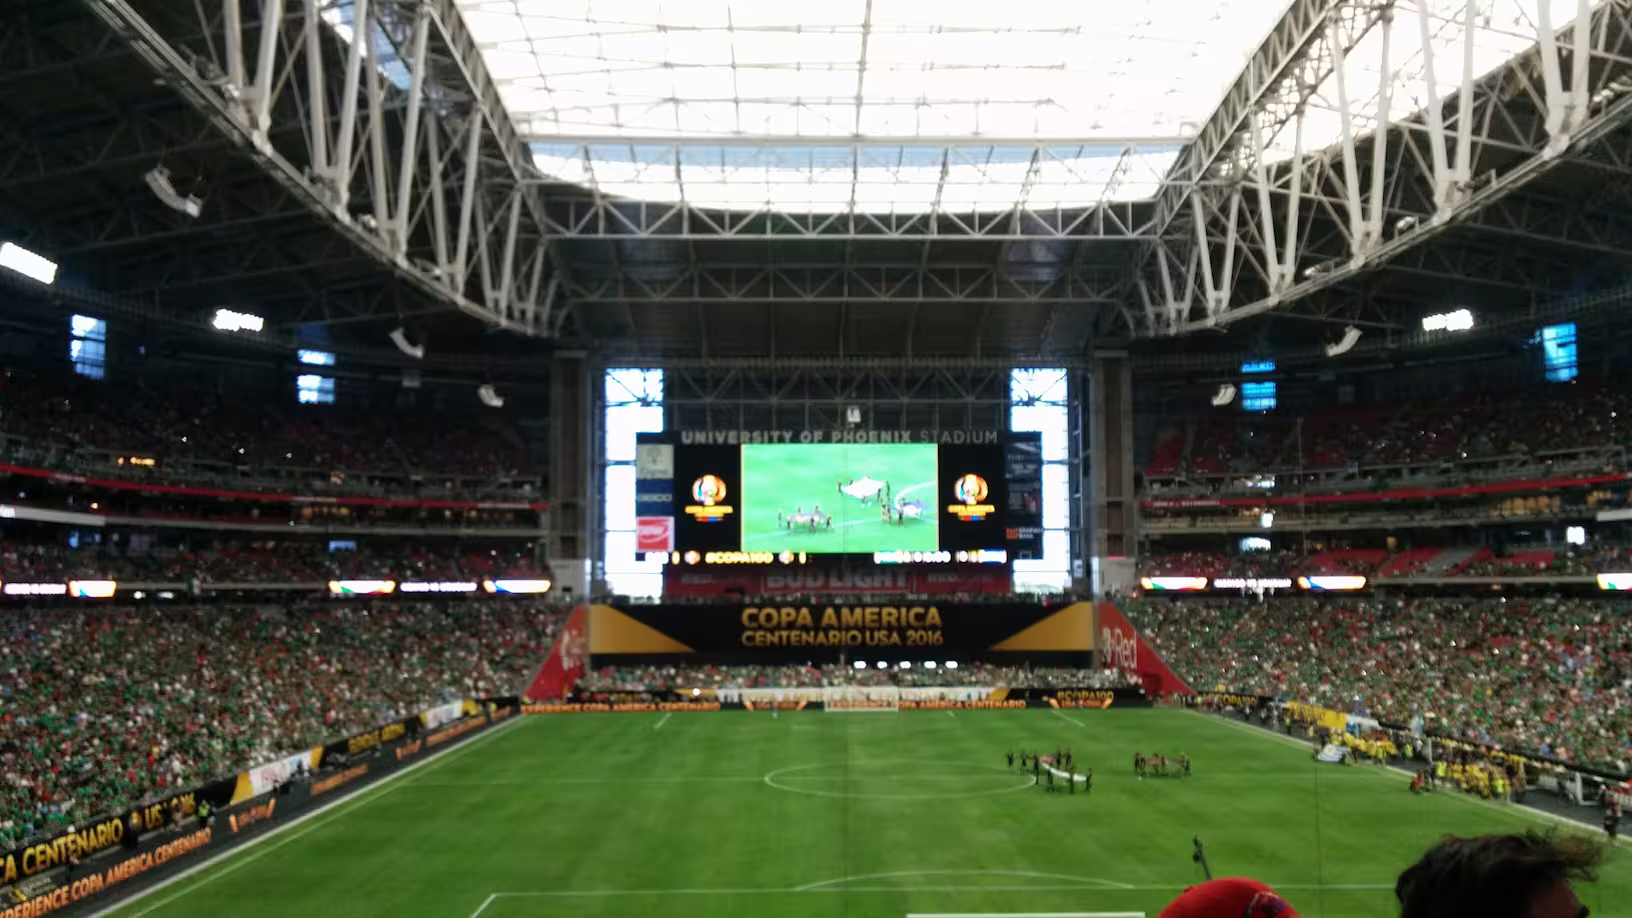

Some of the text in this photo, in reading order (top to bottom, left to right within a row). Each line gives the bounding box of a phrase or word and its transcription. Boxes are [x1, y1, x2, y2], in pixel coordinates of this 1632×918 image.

[681, 430, 998, 444] UNIVERSITY OF PHOENIX STADIUM
[766, 569, 825, 588] BUD
[829, 565, 908, 588] LIGHT
[741, 606, 943, 628] COPA AMERICA
[741, 630, 944, 647] CENTENARIO USA 2016
[965, 700, 1026, 709] CENTENARIO
[1057, 691, 1114, 702] #COPA100
[23, 817, 124, 875] CENTENARIO
[70, 872, 105, 902] COPA
[106, 852, 153, 885] AMERICA
[154, 827, 212, 866] CENTENARIO
